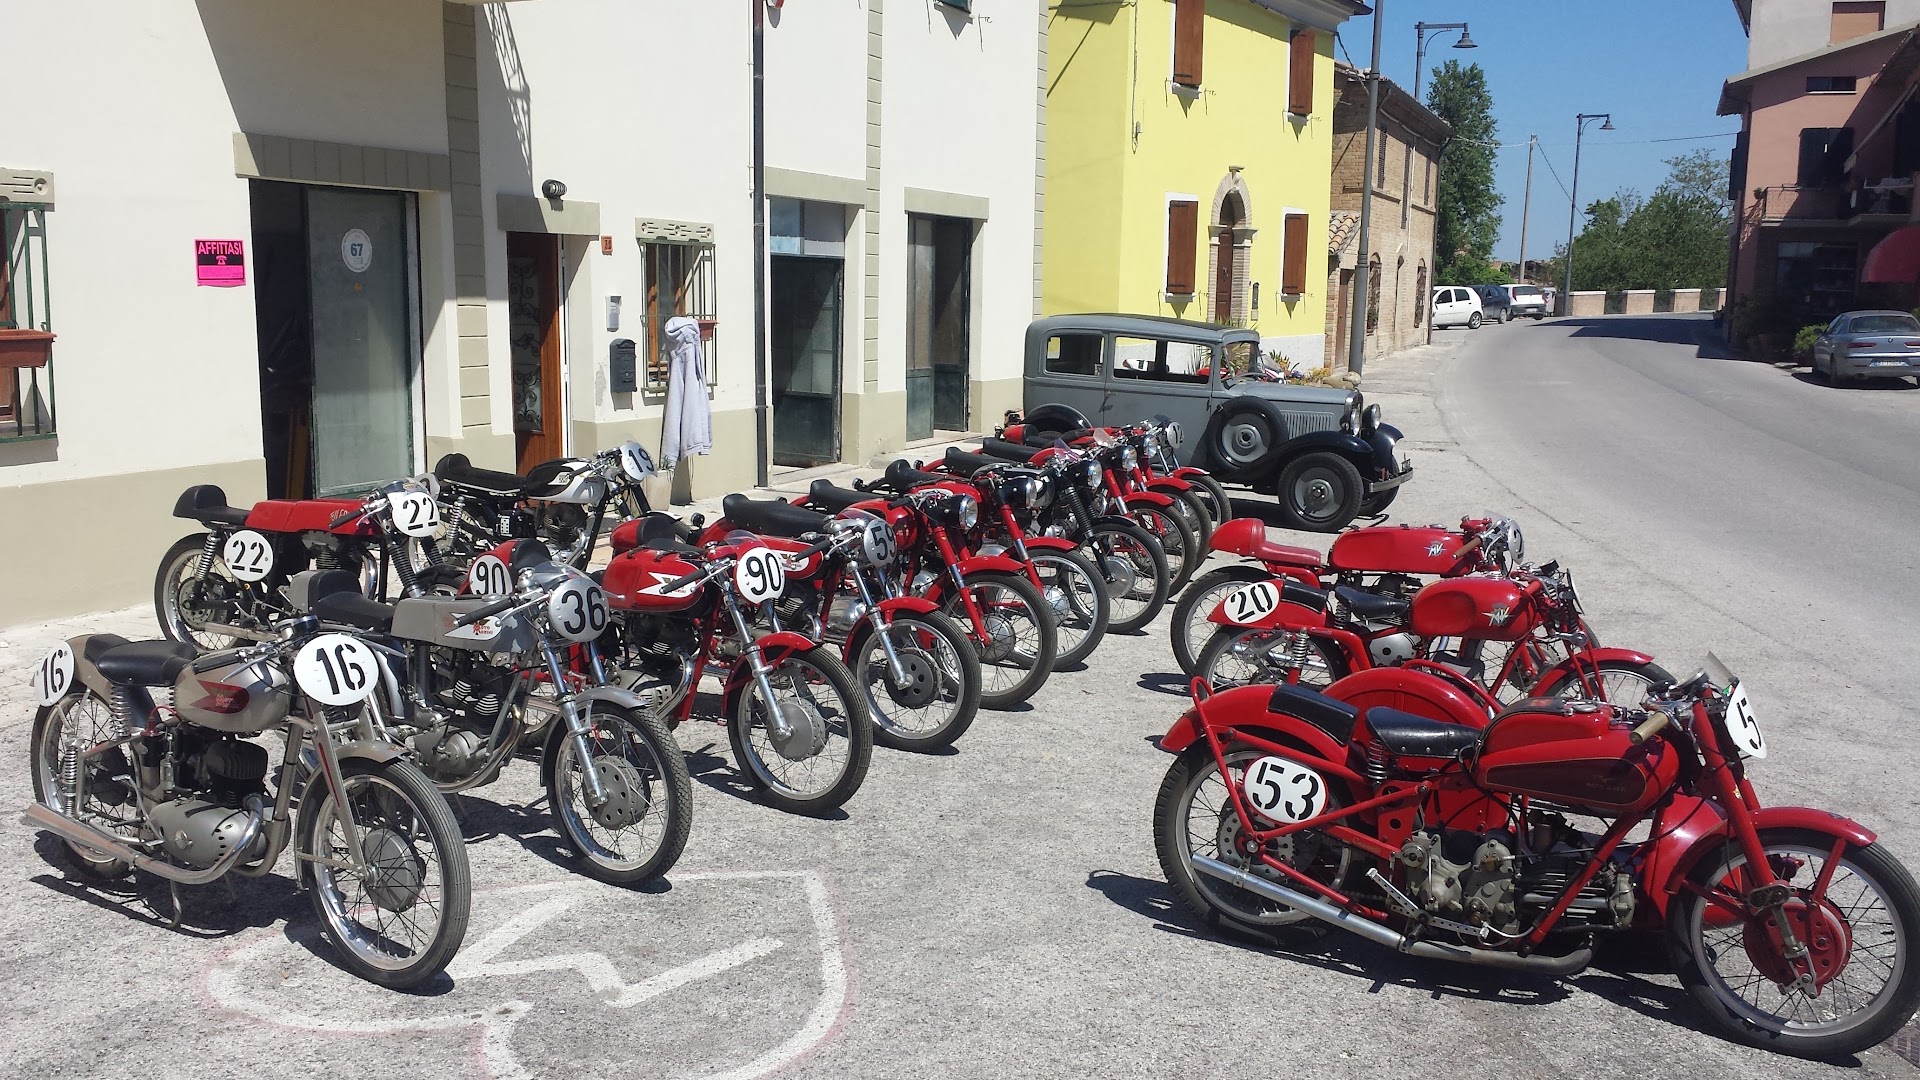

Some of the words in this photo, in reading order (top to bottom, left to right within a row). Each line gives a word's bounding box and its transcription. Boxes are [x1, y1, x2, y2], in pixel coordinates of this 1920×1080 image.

[198, 241, 242, 255] AFFITTASI
[350, 243, 363, 257] 67
[628, 448, 654, 473] 19
[403, 497, 437, 530] 22
[231, 539, 265, 574] 22
[871, 524, 896, 560] 59
[1428, 543, 1443, 557] MV
[476, 561, 506, 595] 90
[746, 552, 781, 595] 90
[561, 586, 605, 634] 36
[1231, 584, 1272, 621] 20
[1489, 607, 1510, 627] MV
[41, 649, 64, 699] 16
[316, 643, 365, 695] 16
[1253, 761, 1319, 820] 53
